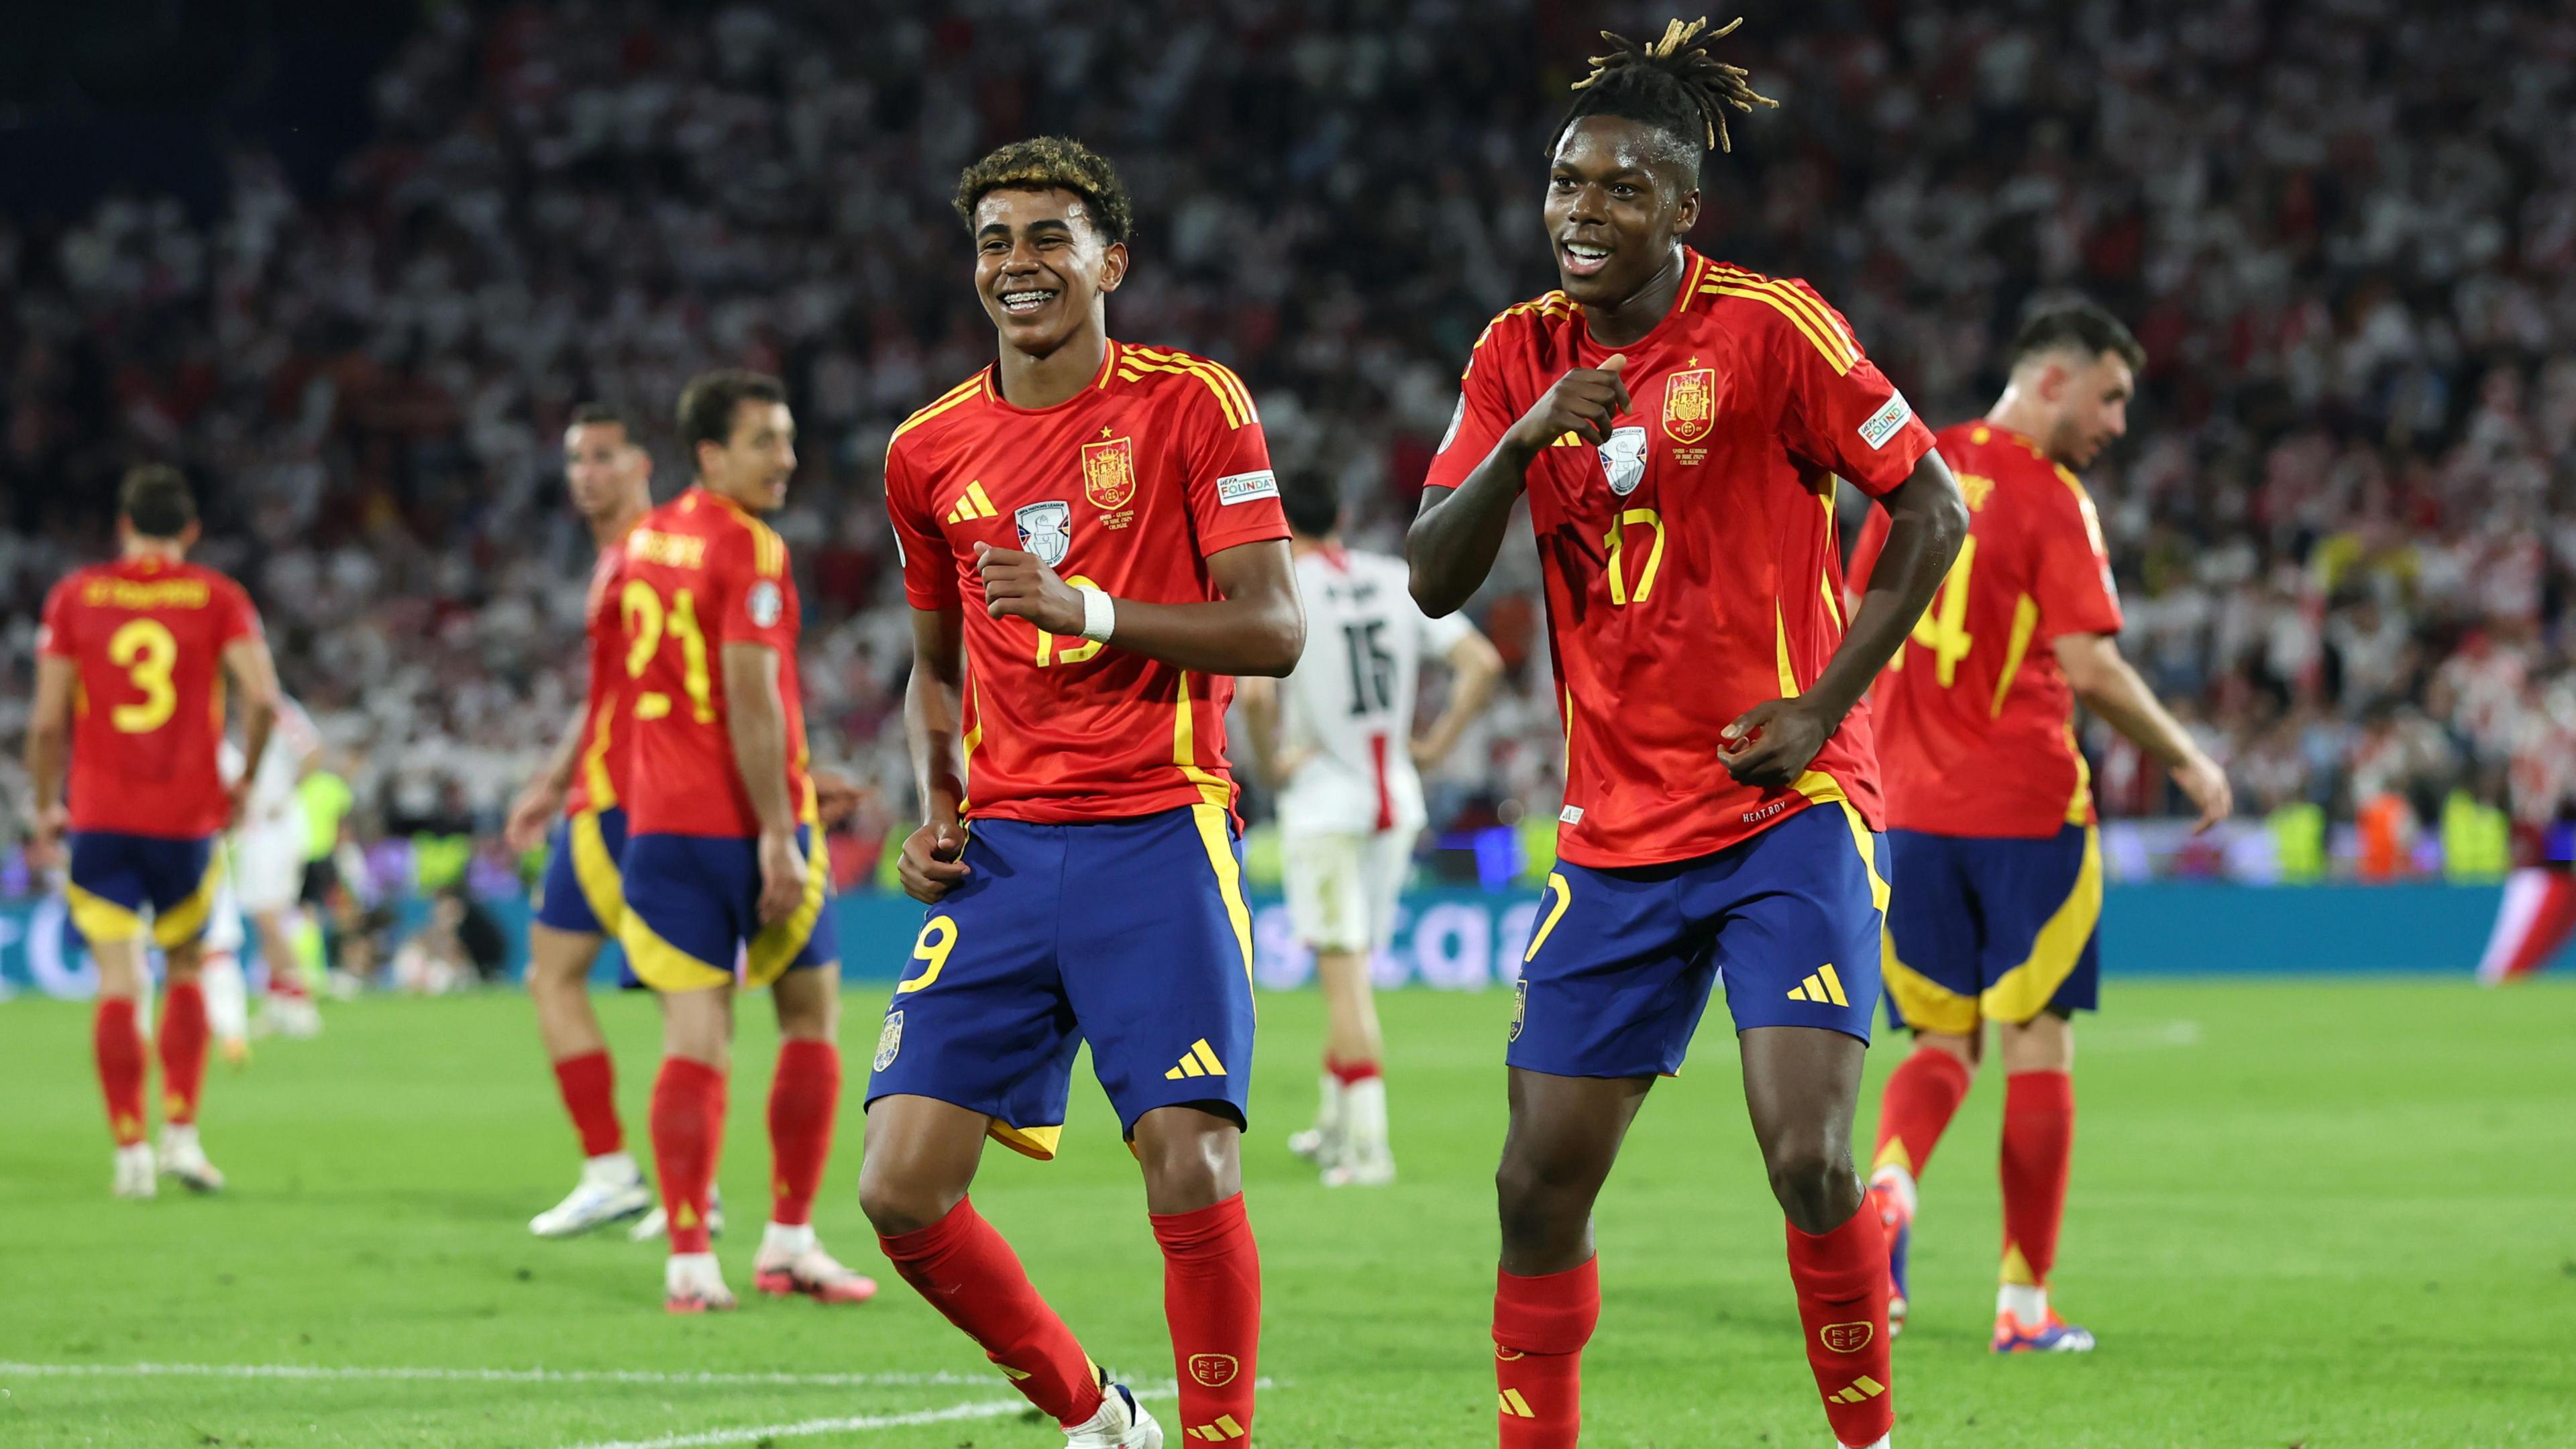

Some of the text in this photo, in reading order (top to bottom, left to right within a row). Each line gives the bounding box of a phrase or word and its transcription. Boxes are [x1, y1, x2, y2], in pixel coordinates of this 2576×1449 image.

[1861, 419, 1877, 433] UEFA
[1220, 478, 1238, 486] UEFA
[1603, 508, 1665, 605] 17
[621, 578, 718, 725] 21
[1888, 533, 1978, 689] 4
[108, 616, 178, 735] 3
[896, 915, 959, 996] 9
